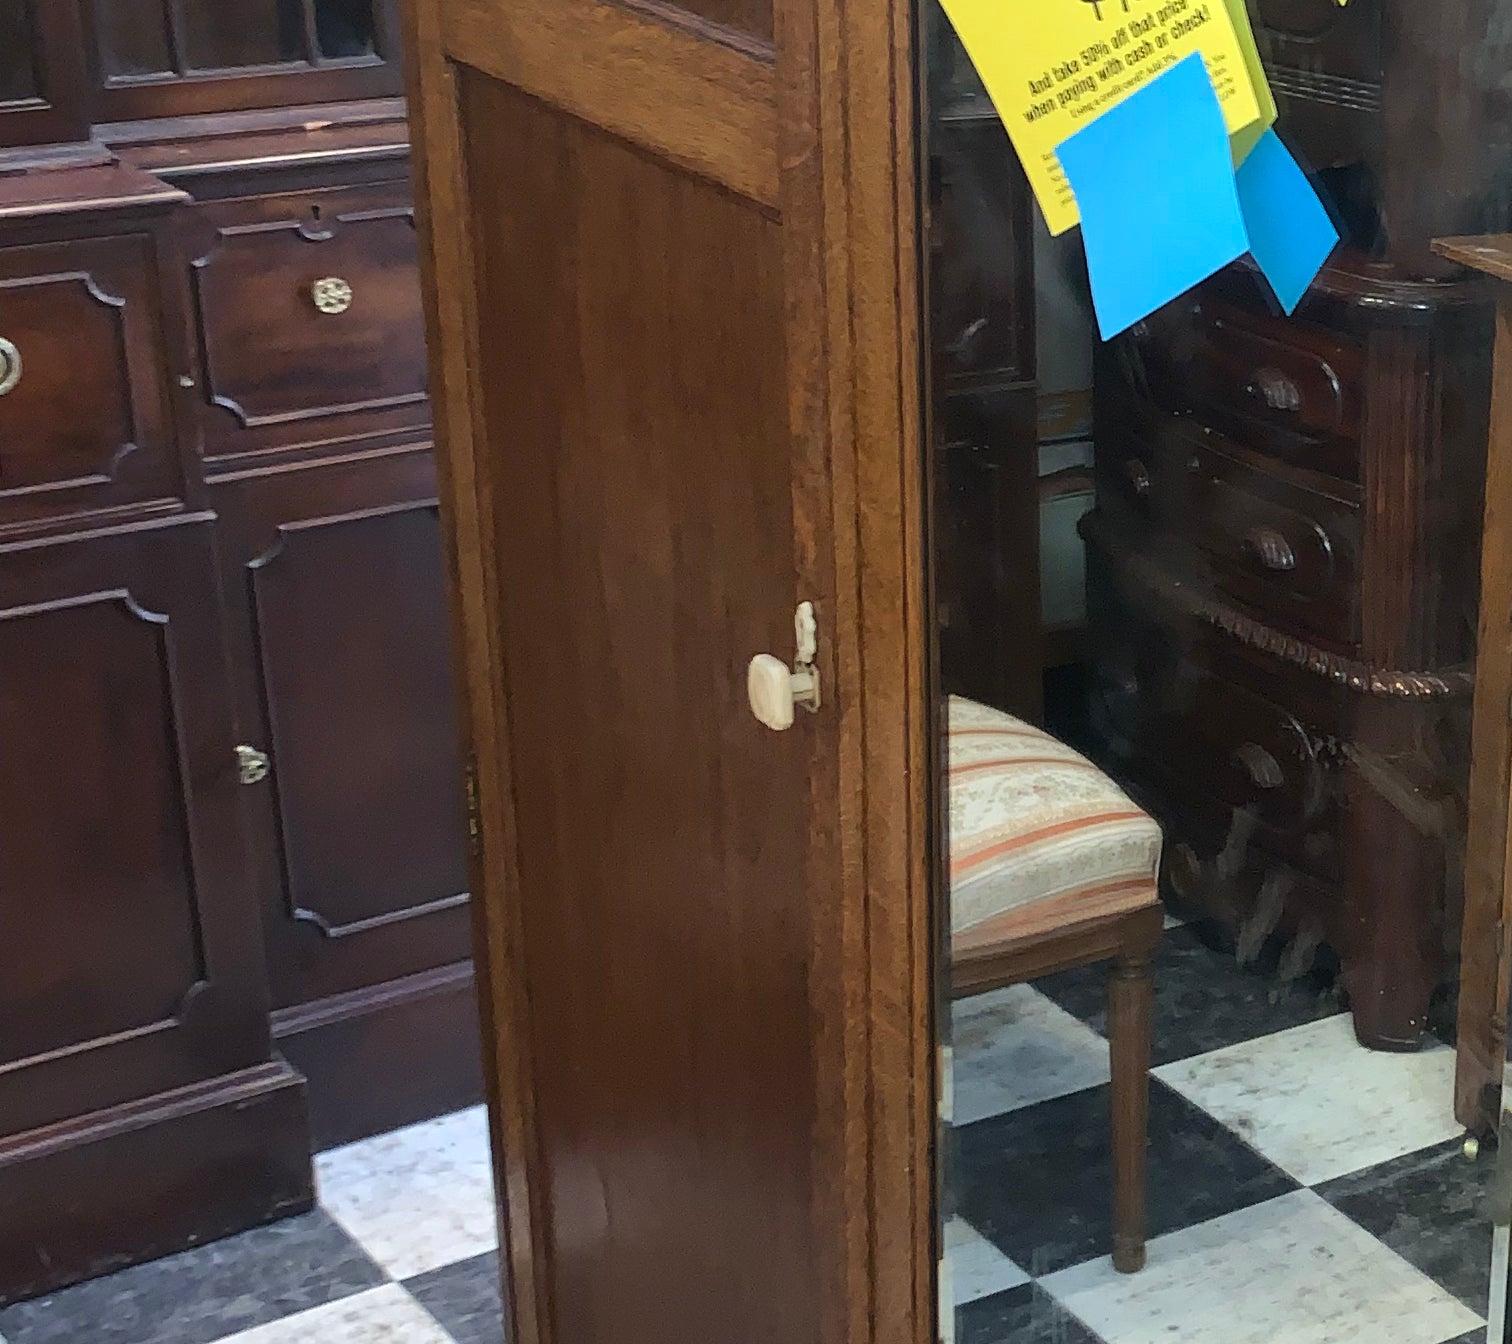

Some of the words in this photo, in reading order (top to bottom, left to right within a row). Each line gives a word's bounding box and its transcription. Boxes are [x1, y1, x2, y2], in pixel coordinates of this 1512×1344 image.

[1023, 97, 1057, 123] when
[1056, 75, 1098, 109] paying
[1095, 56, 1125, 82] with
[1124, 39, 1155, 66] cash
[1154, 32, 1170, 49] or
[1170, 4, 1211, 39] check!
[1028, 71, 1054, 97] And
[1051, 57, 1082, 82] take
[1079, 40, 1112, 67] 50%
[1110, 27, 1130, 50] off
[1128, 12, 1156, 38] that
